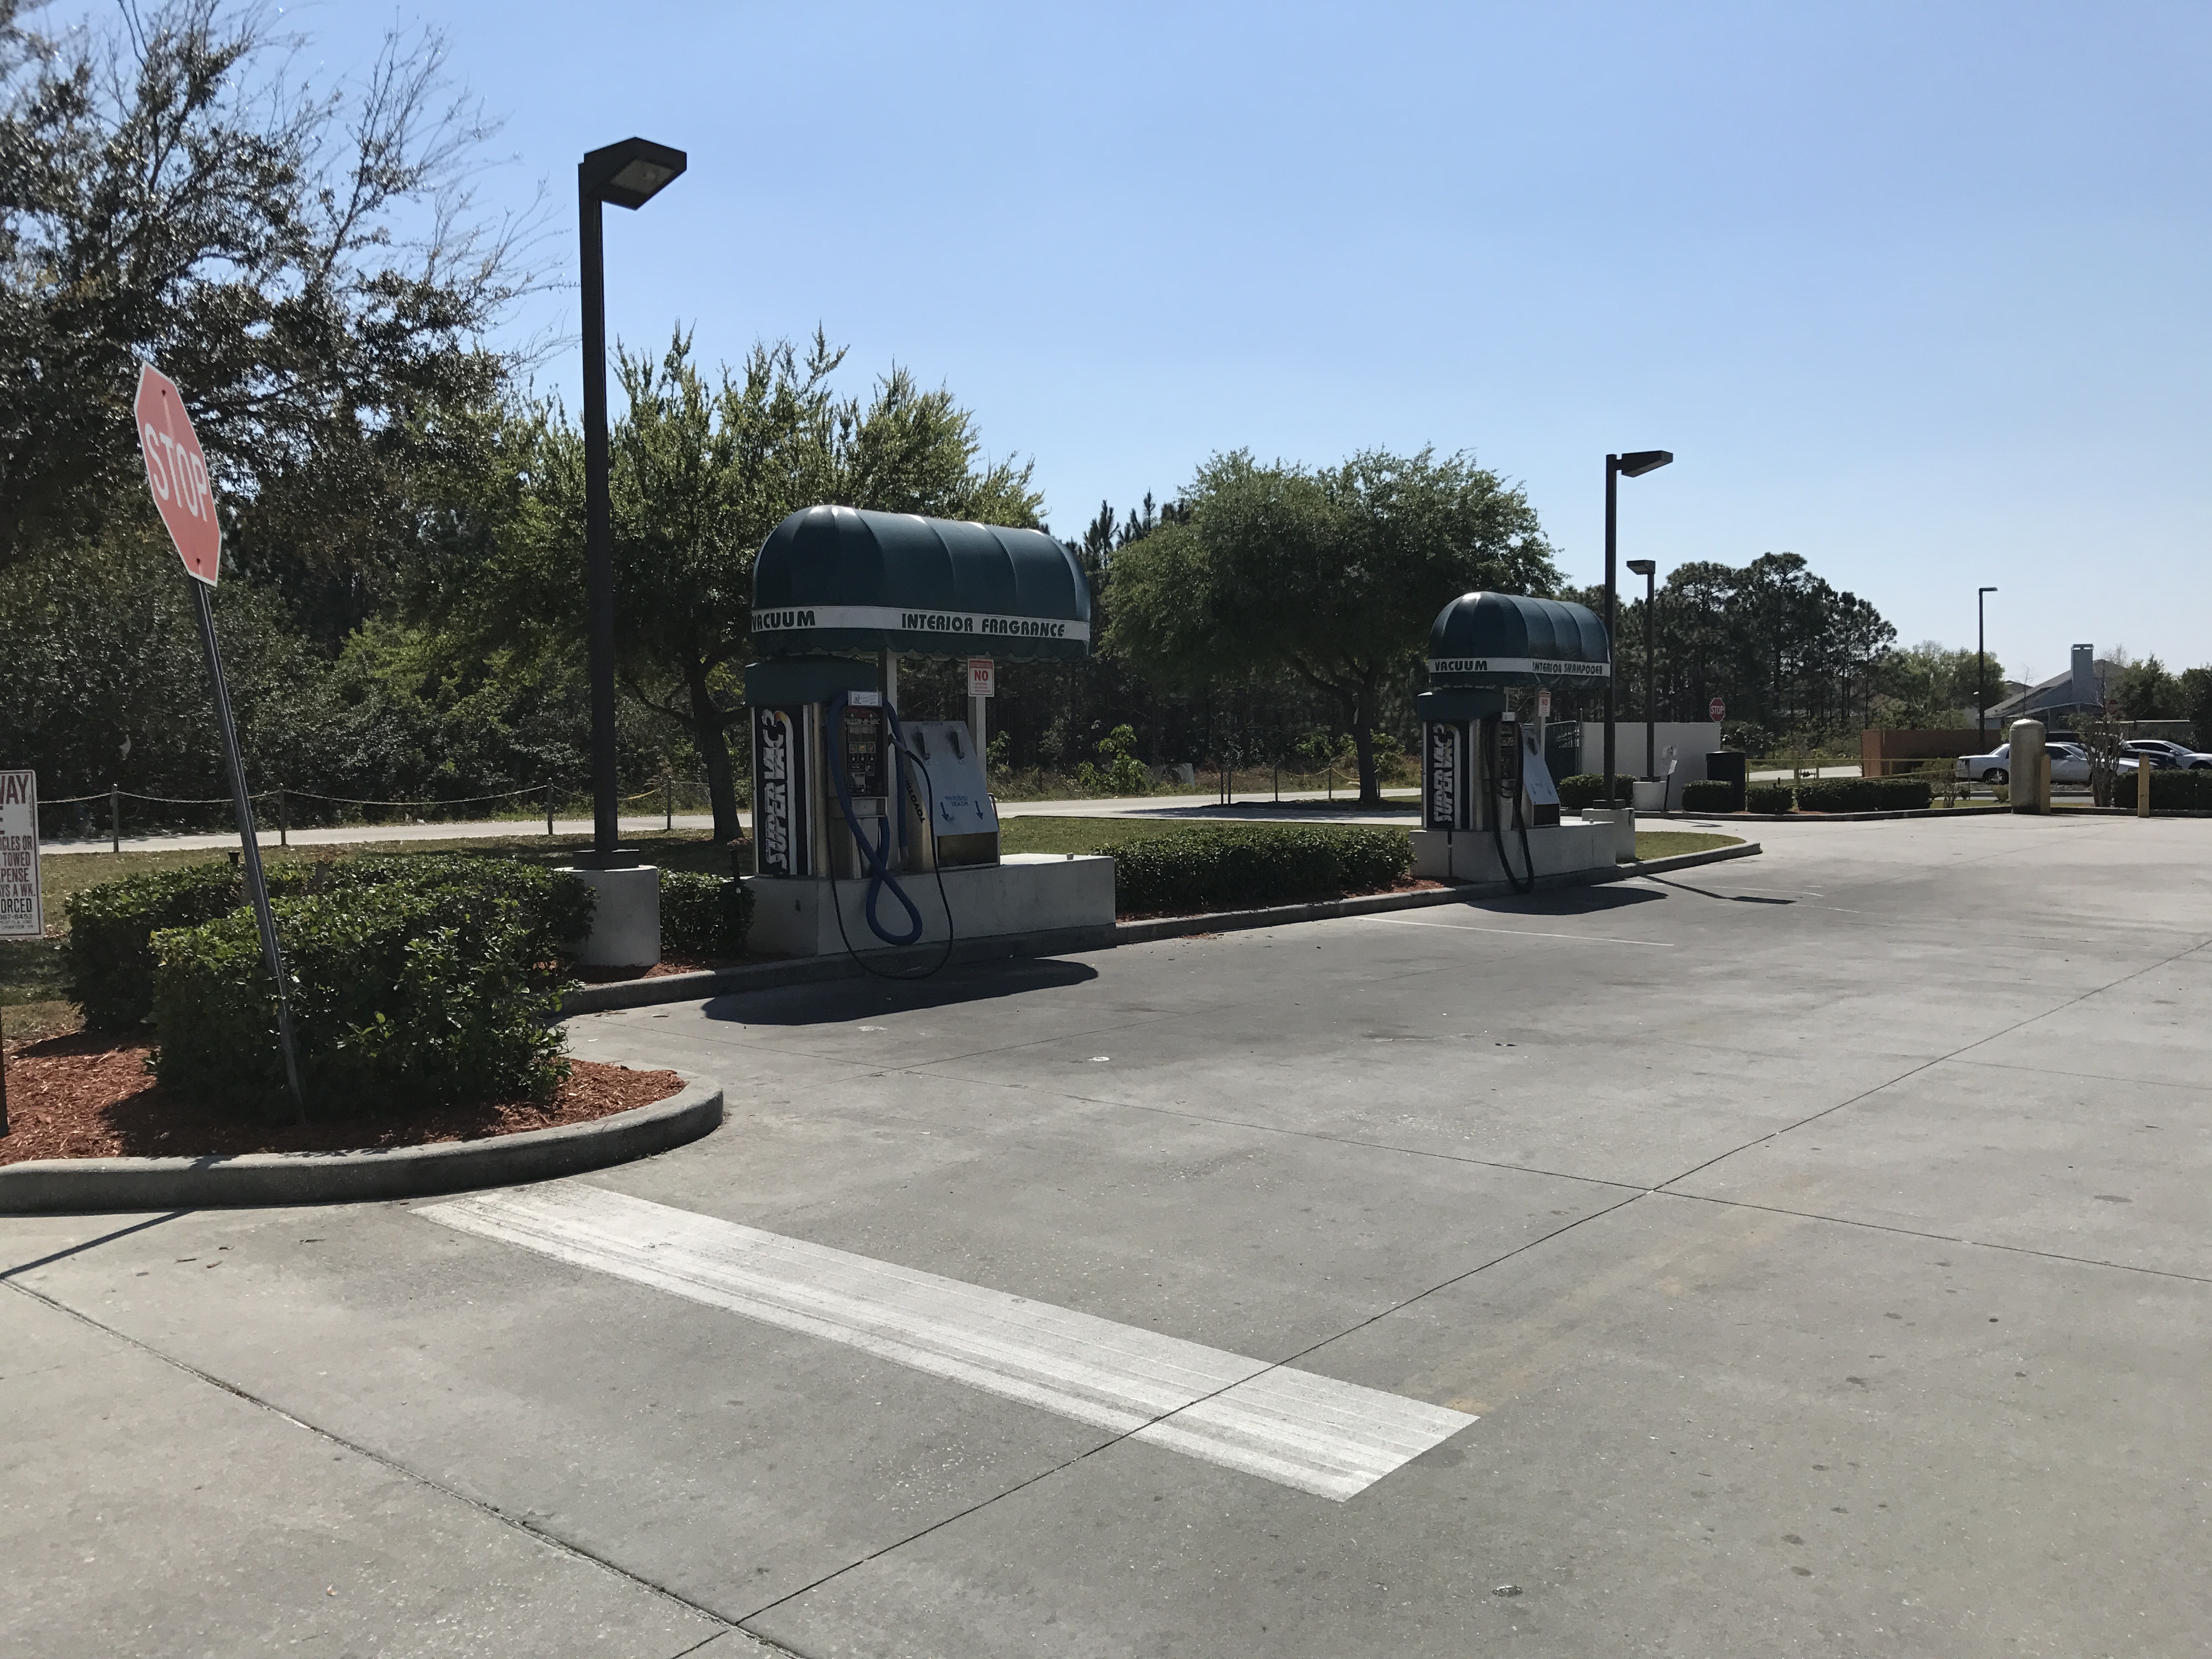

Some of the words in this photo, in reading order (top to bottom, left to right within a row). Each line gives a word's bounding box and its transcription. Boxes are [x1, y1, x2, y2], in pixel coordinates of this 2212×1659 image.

[145, 424, 207, 522] STOP
[752, 611, 816, 631] VACUUM
[901, 613, 974, 632] INTERIOR
[981, 618, 1065, 637] FRAGRANCE
[1435, 660, 1487, 672] VACUUM
[1532, 662, 1562, 673] INTERIOR
[1564, 663, 1602, 675] SHAMPOOER
[974, 670, 989, 681] NO
[1711, 706, 1724, 714] STOP
[763, 729, 786, 780] VAC
[1433, 770, 1453, 822] SUPER
[763, 781, 788, 870] SUPER
[22, 836, 33, 850] OR
[3, 851, 30, 866] TOWED
[0, 868, 30, 882] PENSE
[0, 884, 10, 898] YS
[13, 883, 19, 897] A
[1, 898, 32, 913] ORCED
